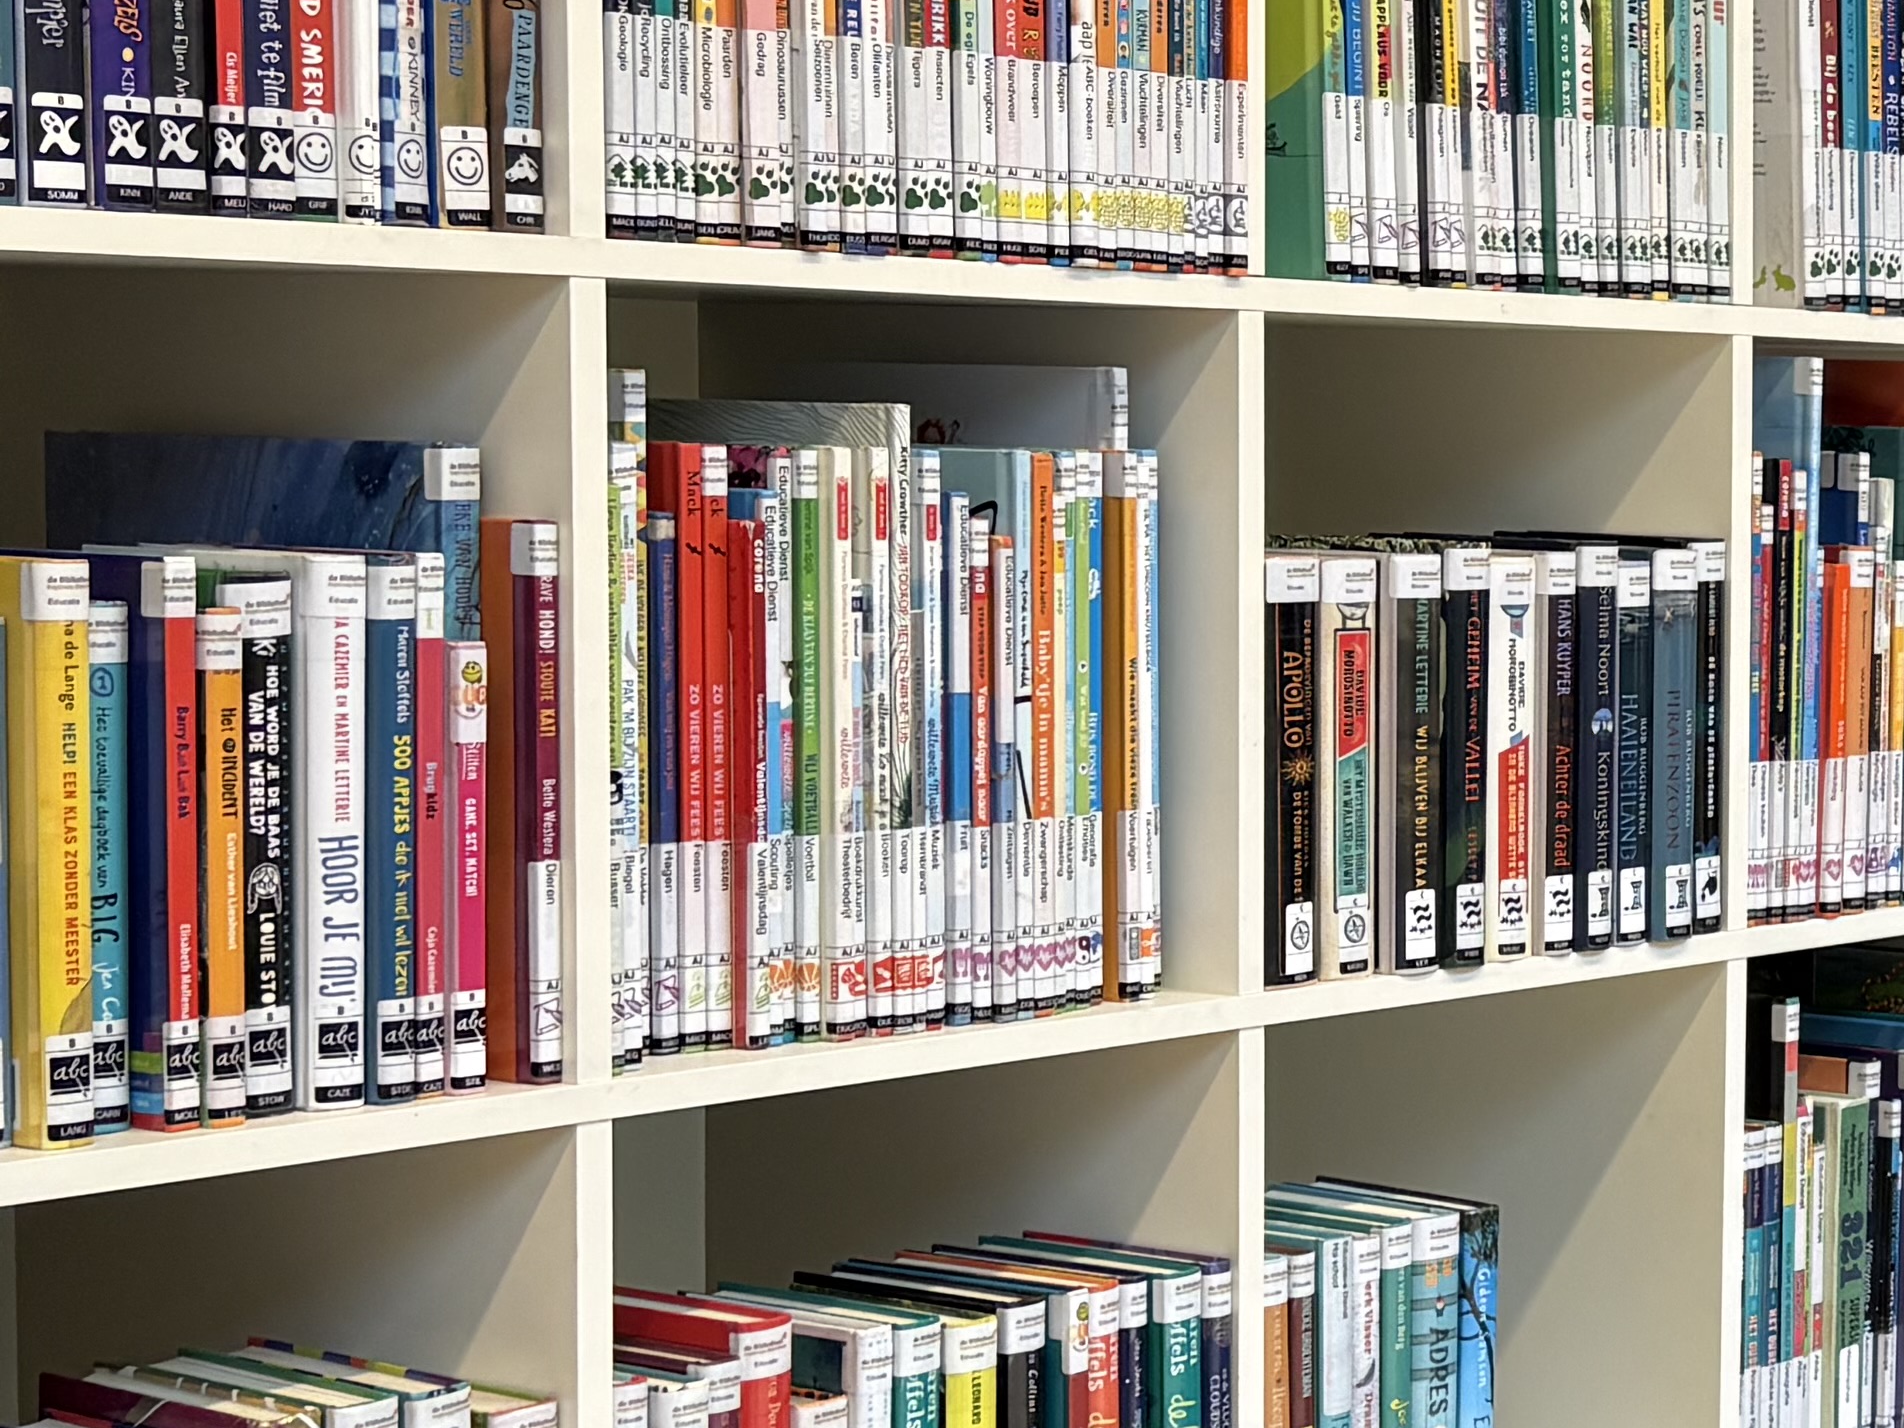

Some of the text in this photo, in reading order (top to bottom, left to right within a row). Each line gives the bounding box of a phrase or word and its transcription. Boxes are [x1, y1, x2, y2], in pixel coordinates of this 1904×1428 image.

[172, 35, 189, 72] Ellen
[261, 41, 281, 65] te
[539, 610, 555, 702] HOND! STOUTE
[1415, 663, 1429, 714] LETTERIE
[1557, 599, 1571, 696] HANS KUYPER
[1598, 644, 1611, 696] Noort
[221, 708, 238, 732] Het
[334, 635, 351, 822] CAZEMIER MARTINE LETTERIE
[690, 708, 701, 765] VIEREN
[713, 708, 724, 765] VIEREN
[1282, 651, 1304, 749] APOLLO
[1465, 618, 1482, 802] GEHEIM VALLEI
[248, 691, 266, 835] VAN DE WERELD?
[266, 665, 281, 859] HOE WORD JE DE BAAS
[394, 735, 412, 834] 500 APPJES
[1415, 725, 1429, 801] WIJ BLIJVEN
[1554, 745, 1570, 867] Achter de draad
[1620, 694, 1638, 860] HAAIENEILAND
[1666, 689, 1681, 850] PIRATENZOON
[58, 663, 80, 986] Lange EEN KLAS ZONDER MEESTER
[317, 835, 360, 942] HOOR JE
[259, 912, 276, 964] LOUIE
[1429, 1327, 1449, 1417] ADRES
